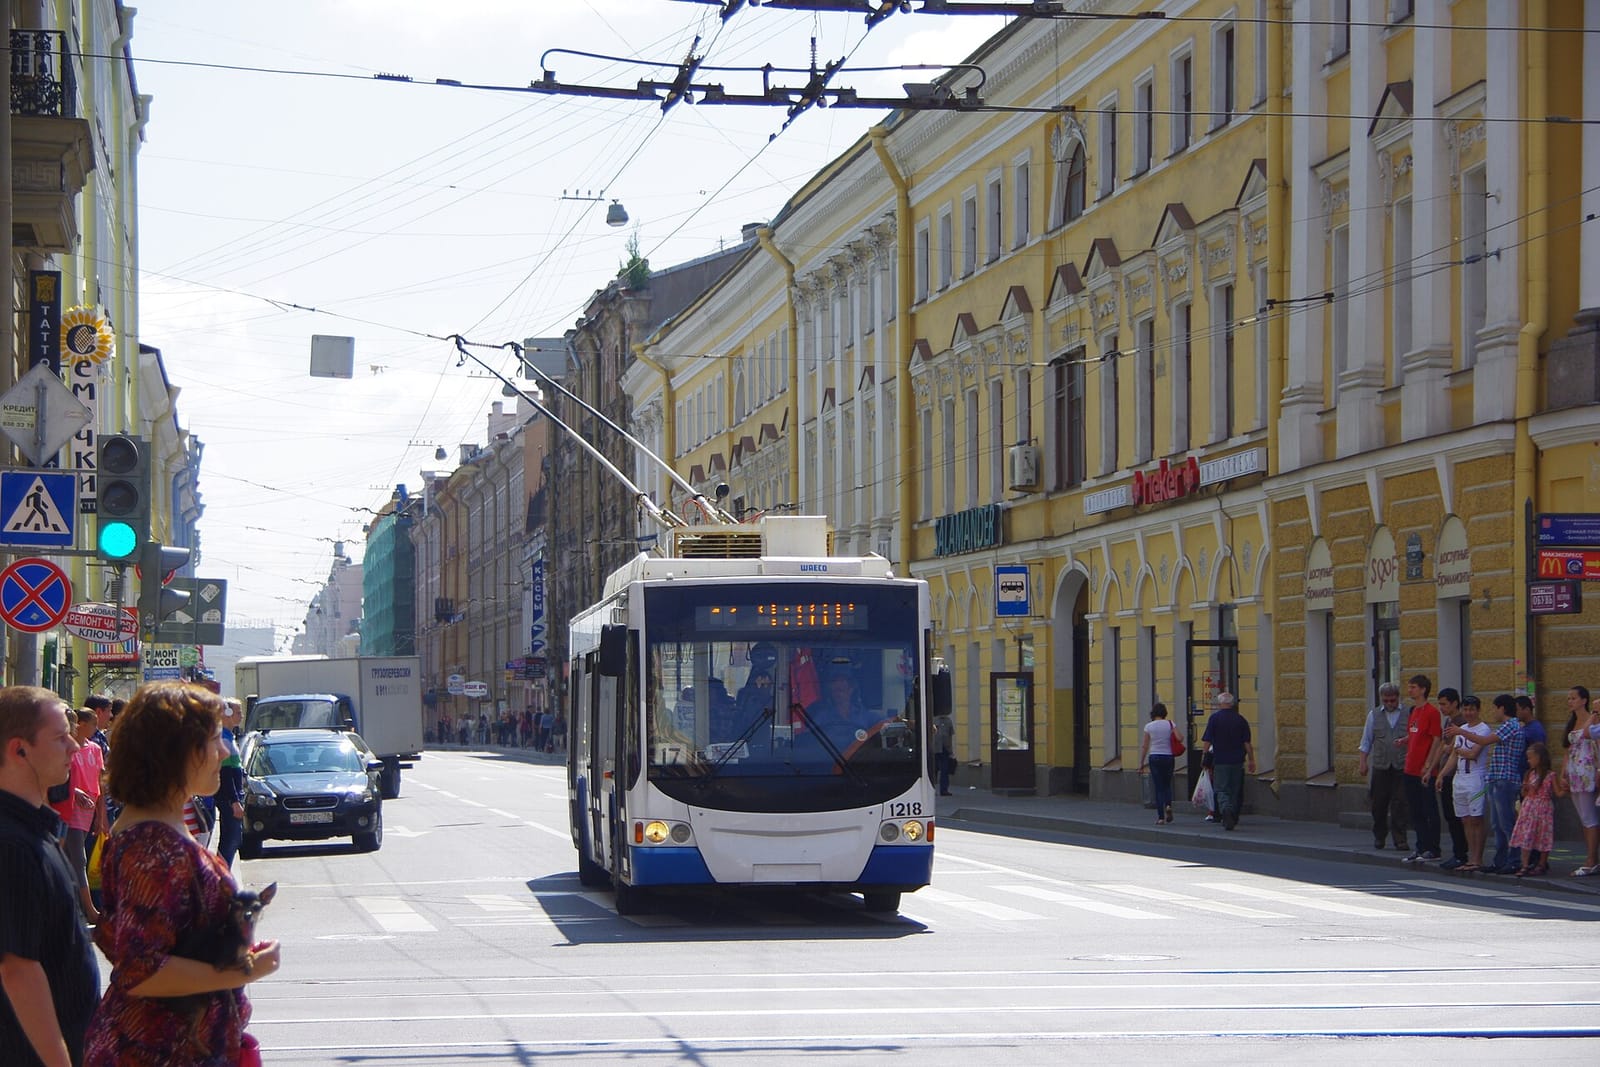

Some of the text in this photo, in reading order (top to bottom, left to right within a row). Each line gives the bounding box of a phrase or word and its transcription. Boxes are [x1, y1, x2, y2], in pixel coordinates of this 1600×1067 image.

[935, 504, 995, 557] SALAMANDER
[800, 564, 828, 572] WAECO
[533, 566, 543, 611] КАССЫ
[69, 614, 131, 632] РЕМОНТ ЧАОВ
[78, 628, 121, 641] КЛЮЧИ
[145, 649, 178, 658] РМОНТ
[371, 667, 411, 679] ГРУЗОПЕРЕВОЗКИ
[662, 747, 681, 765] 17
[890, 802, 922, 817] 1218
